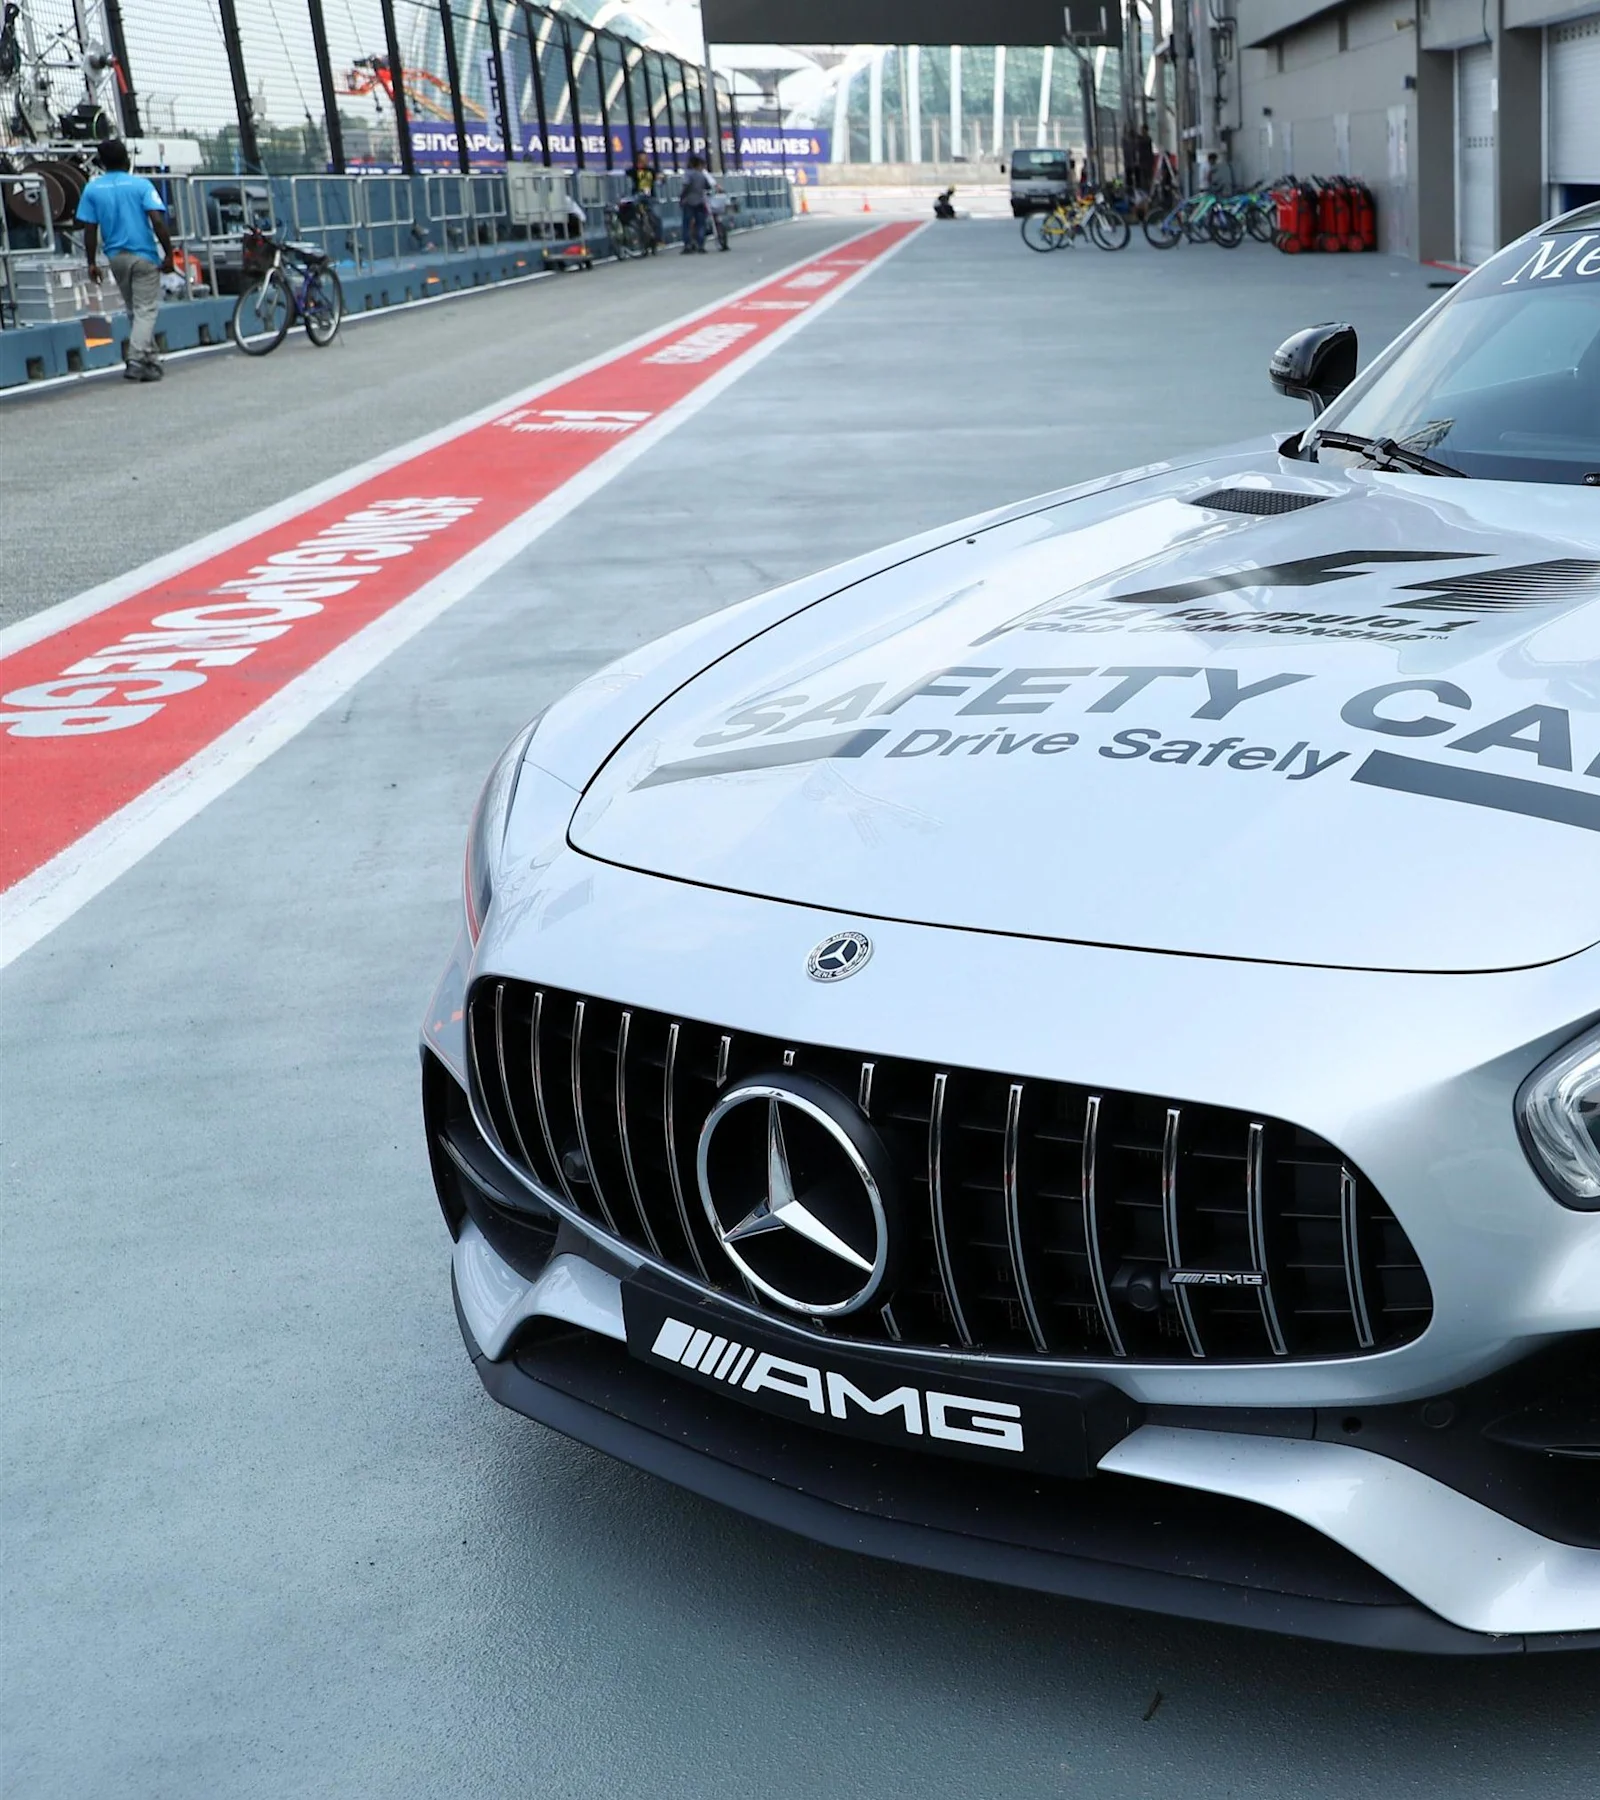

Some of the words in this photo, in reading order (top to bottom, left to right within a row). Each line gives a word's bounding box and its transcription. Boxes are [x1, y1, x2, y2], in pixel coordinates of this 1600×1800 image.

[529, 134, 607, 153] ARLINES
[739, 137, 810, 155] AIRLINES
[0, 496, 484, 738] #SINGAPOREGP
[1147, 608, 1423, 629] Formula
[1420, 620, 1481, 633] 1
[694, 666, 1316, 748] SAFETY
[885, 727, 1081, 759] Drive
[1099, 728, 1352, 782] Safely
[1200, 1273, 1263, 1285] AMG
[742, 1351, 1025, 1452] AMG
